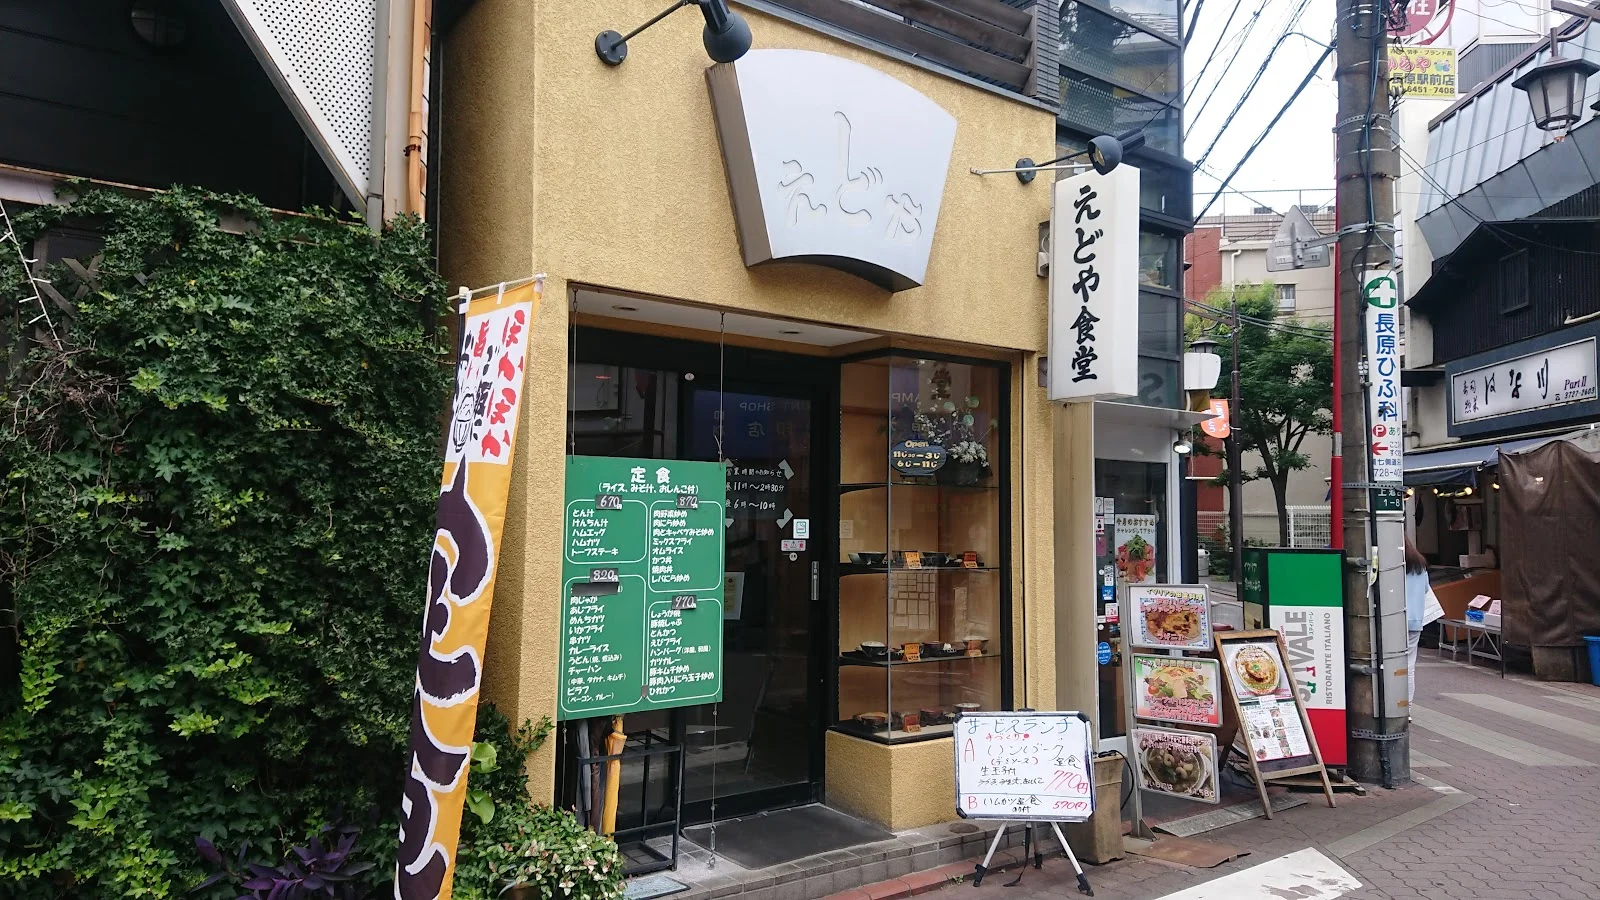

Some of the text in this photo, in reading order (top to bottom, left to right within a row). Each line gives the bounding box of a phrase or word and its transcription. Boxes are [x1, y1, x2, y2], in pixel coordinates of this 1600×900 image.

[1070, 184, 1104, 383] えどや食堂
[1374, 313, 1398, 422] 長原ひふ科
[905, 440, 930, 449] Open
[631, 466, 671, 484] 定食
[1383, 499, 1400, 507] 1-8
[572, 508, 595, 518] とん汁
[653, 509, 688, 518] 肉野菜炒め
[571, 518, 609, 528] けんちん汁
[653, 519, 687, 528] 肉にら炒め
[571, 528, 607, 537] ハムエッグ
[571, 537, 601, 547] ハムカツ
[652, 537, 693, 546] ミックスフライ
[571, 547, 619, 557] トーフステーキ
[652, 546, 684, 555] オムライス
[652, 556, 673, 565] かつ丼
[651, 574, 690, 583] レバにら炒め
[570, 596, 598, 605] 肉じゃが
[569, 605, 605, 615] あじフライ
[569, 614, 605, 625] めんちカツ
[569, 624, 605, 635] いかフライ
[650, 628, 676, 638] とんかつ
[569, 635, 591, 645] 串カツ
[650, 637, 682, 647] えびフライ
[568, 644, 610, 655] カレーライス
[650, 657, 682, 667] カツカレー
[1323, 612, 1333, 705] RISTORANTE ITALIANO
[568, 664, 602, 676] チャーハン
[649, 665, 690, 677] 豚キムチ炒め
[649, 672, 715, 687] 豚肉入りにら玉子炒め
[567, 686, 590, 696] ピラフ
[649, 686, 676, 696] ひれかつ
[964, 738, 975, 762] A
[968, 796, 978, 810] B
